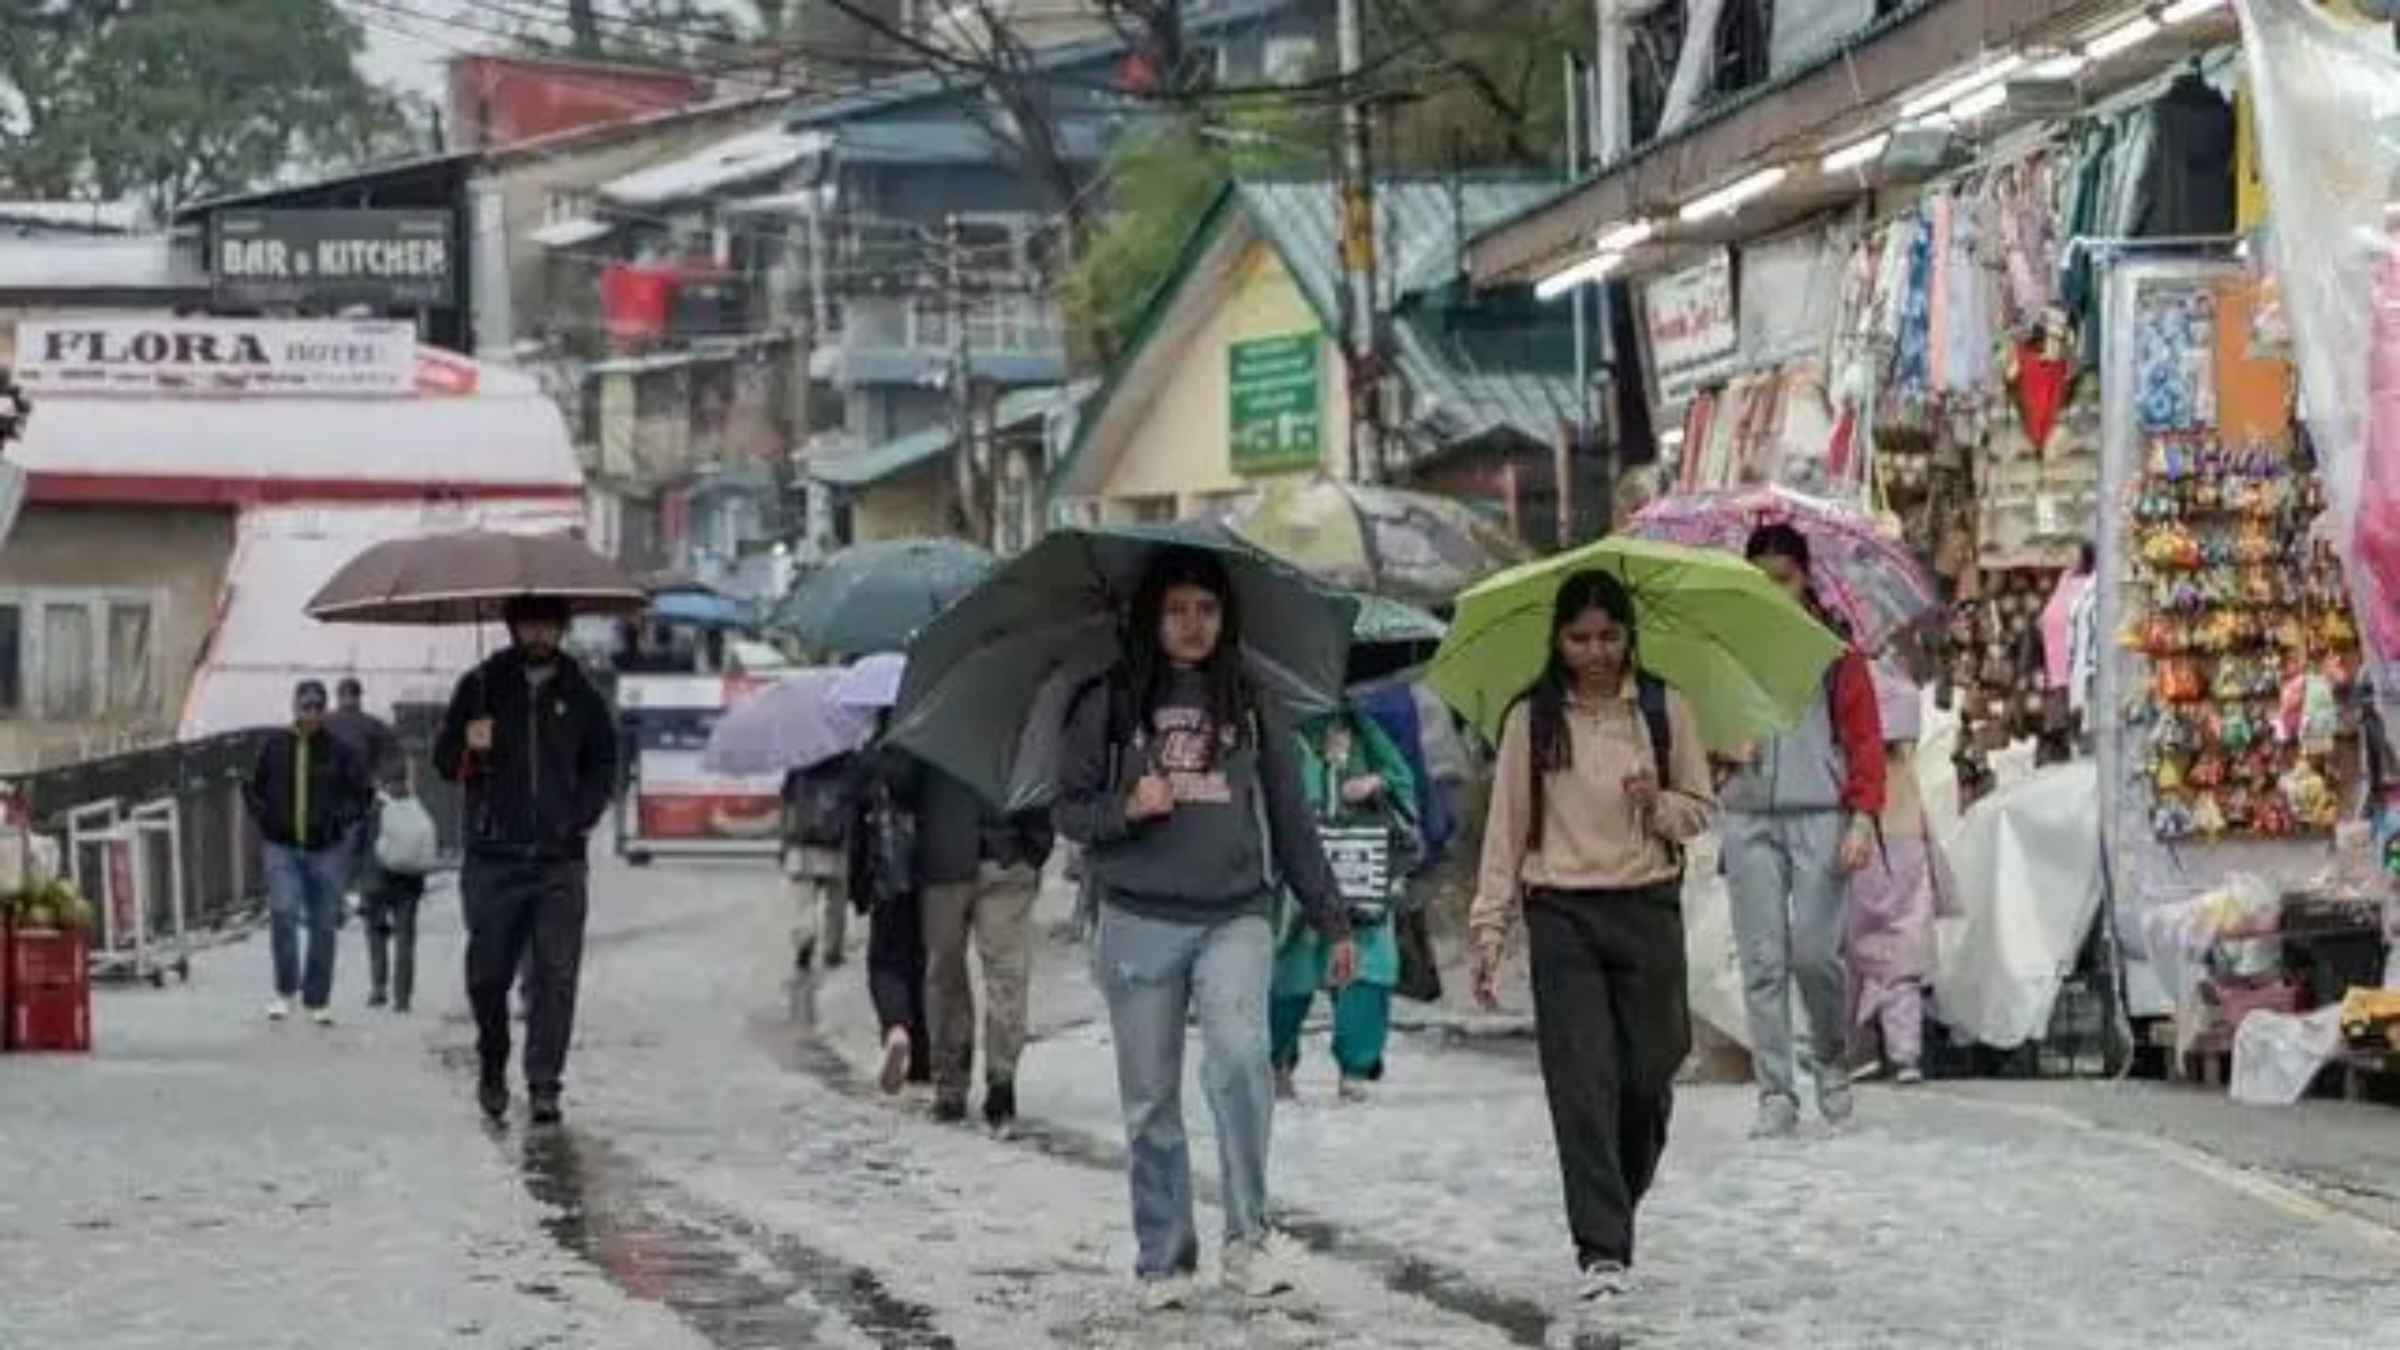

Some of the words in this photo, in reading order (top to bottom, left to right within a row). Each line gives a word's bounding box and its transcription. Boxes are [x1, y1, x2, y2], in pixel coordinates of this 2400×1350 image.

[223, 239, 287, 275] BAR
[318, 239, 446, 276] KITCHEN
[45, 330, 270, 364] FLORA
